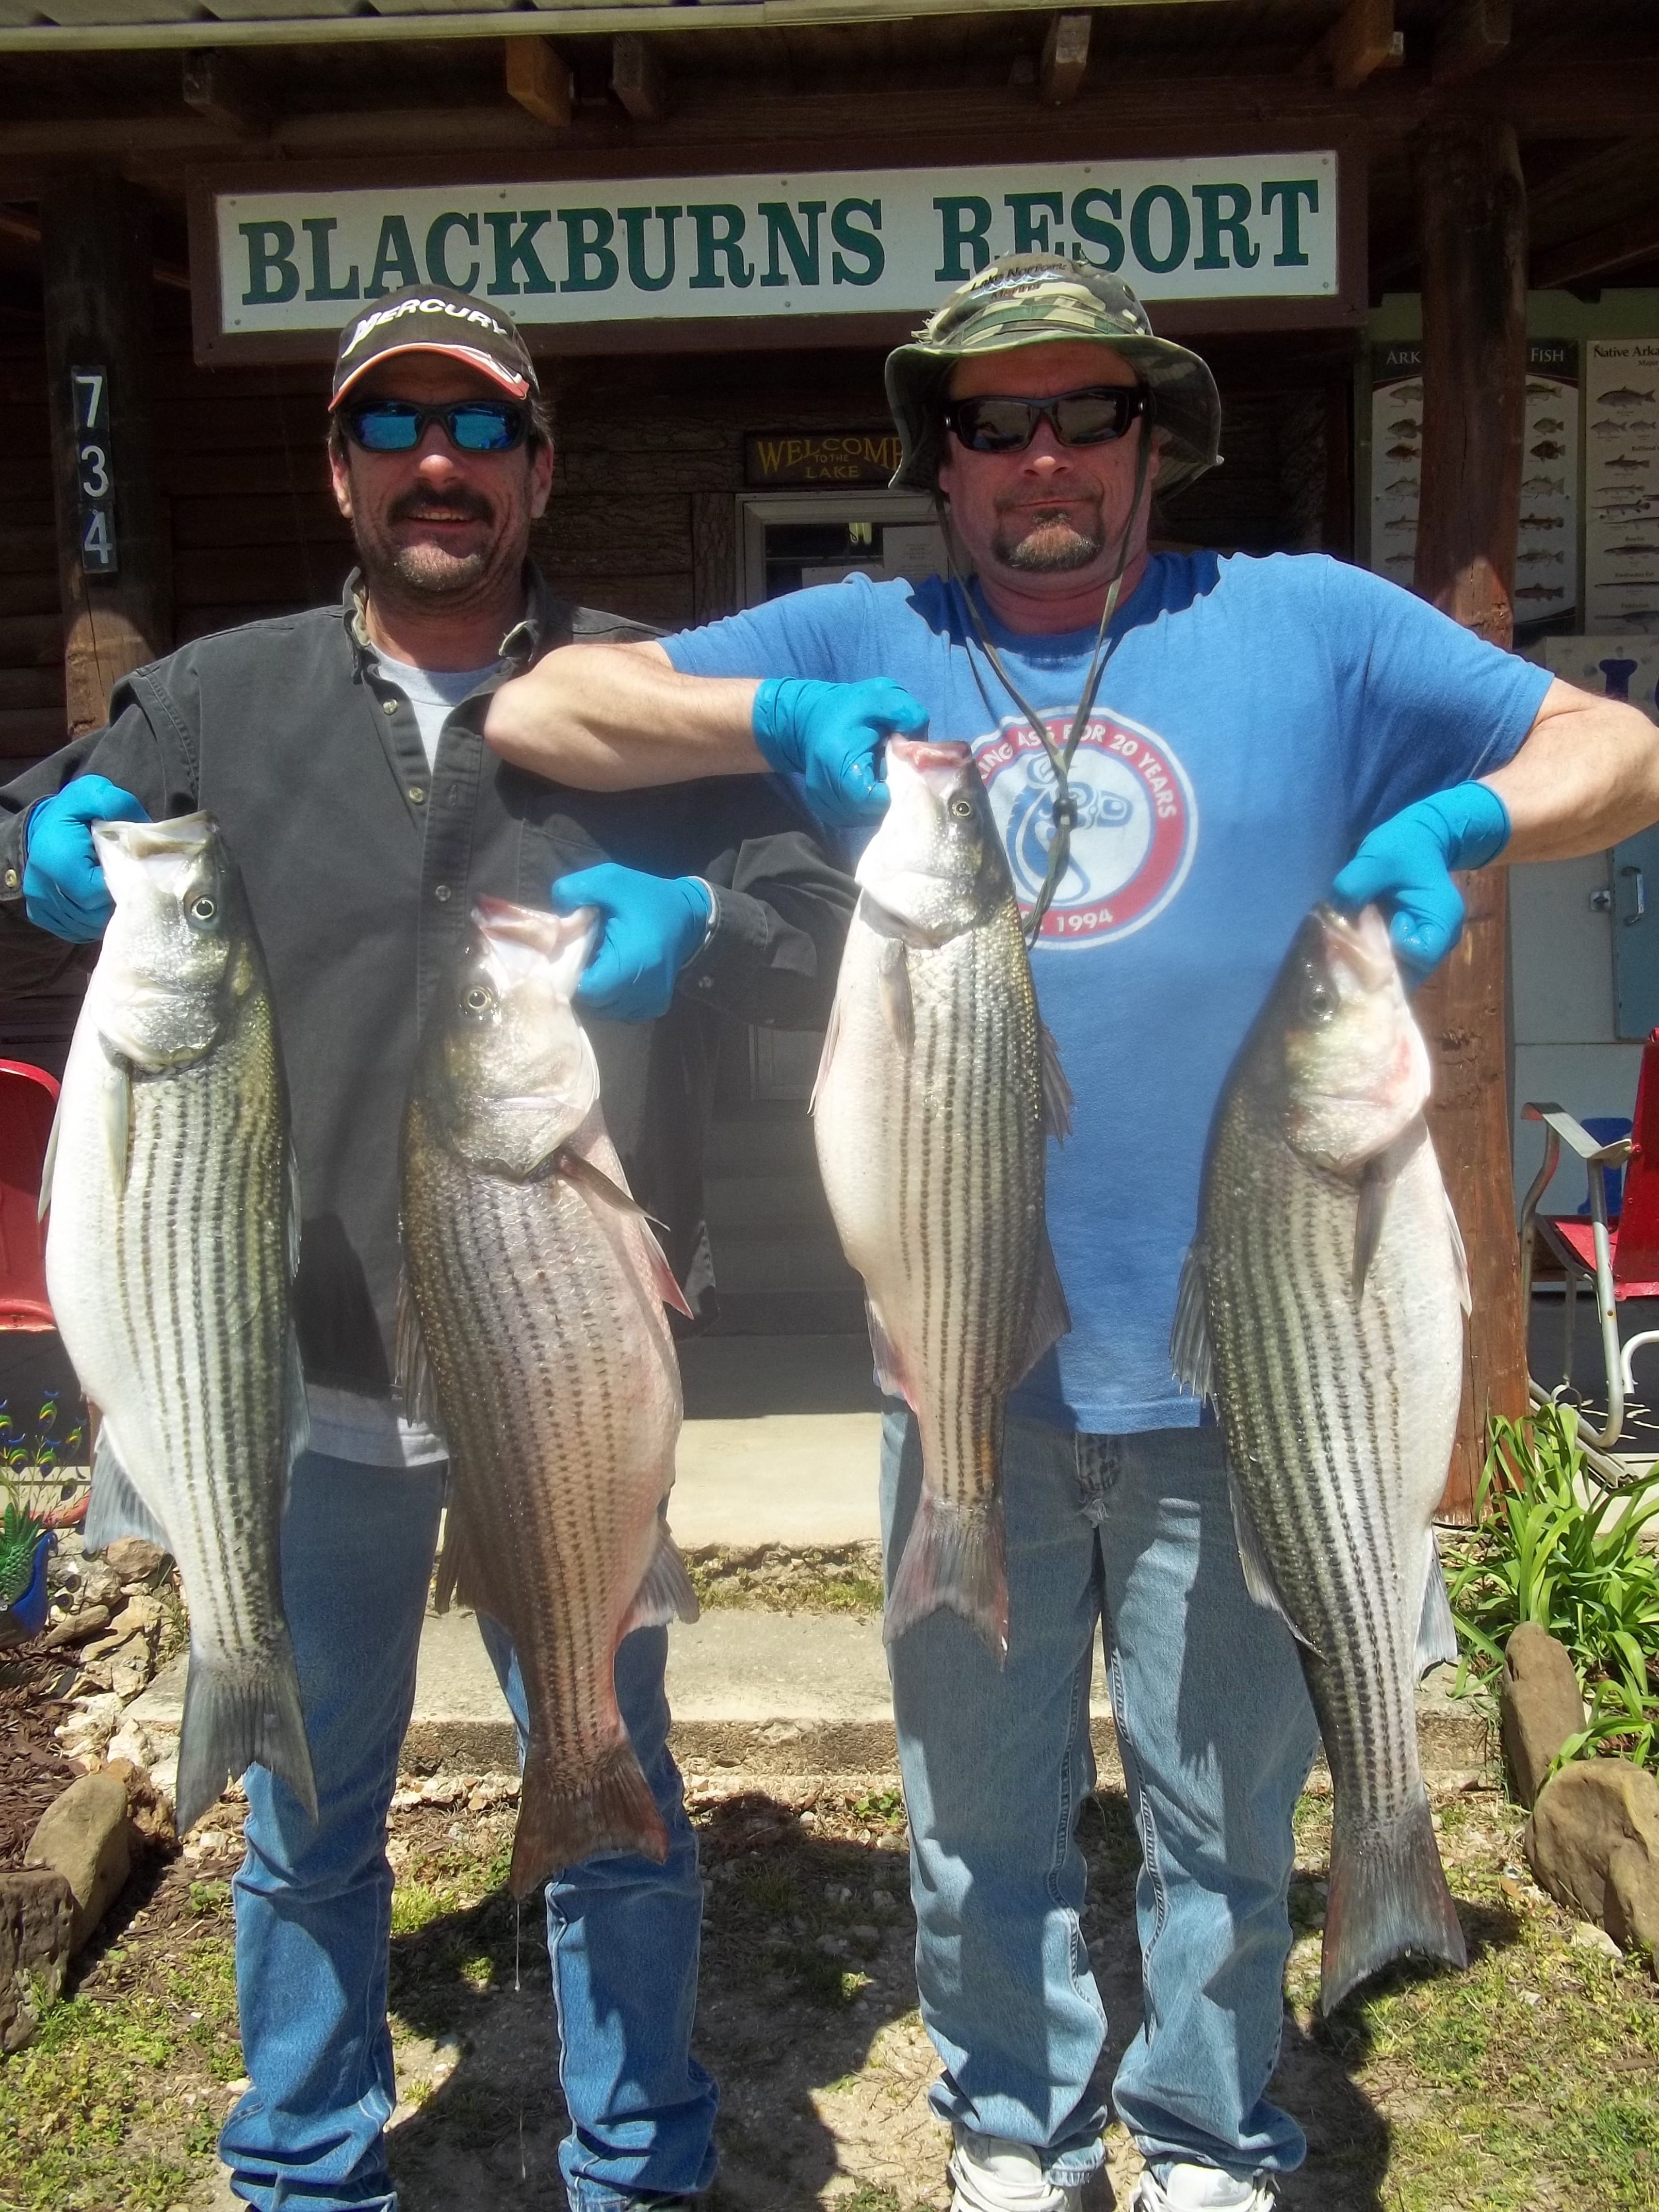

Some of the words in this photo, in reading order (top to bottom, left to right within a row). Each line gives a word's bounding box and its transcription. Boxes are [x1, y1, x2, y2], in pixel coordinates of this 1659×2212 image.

[238, 197, 886, 306] BLACKBURNS
[934, 179, 1319, 282] RESORT
[970, 274, 1004, 291] Lake
[991, 284, 1040, 299] Marina
[341, 298, 508, 359] MERCURY
[1530, 347, 1564, 362] FISH
[1593, 346, 1629, 358] Native
[815, 454, 828, 463] TO
[805, 466, 860, 479] LAKE
[1108, 734, 1138, 756] 20
[1137, 752, 1177, 818] YEARS
[1056, 908, 1113, 932] 1994
